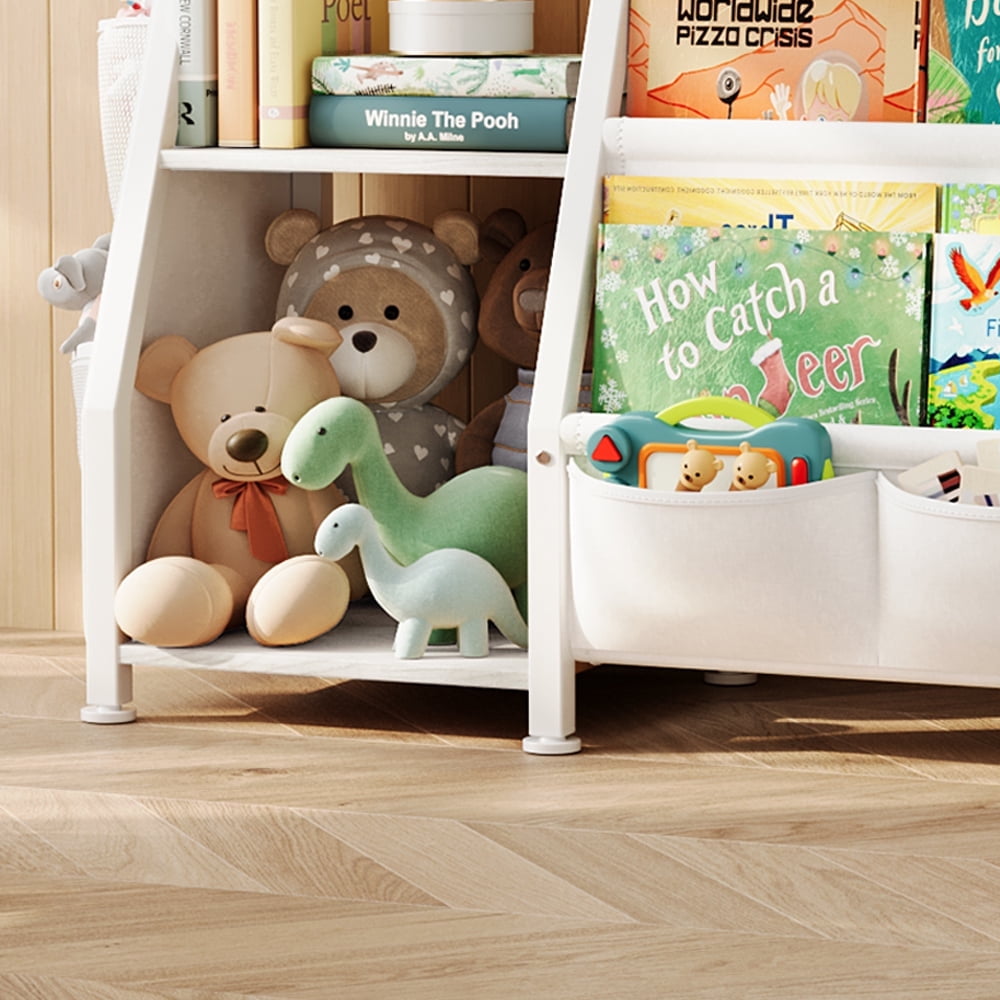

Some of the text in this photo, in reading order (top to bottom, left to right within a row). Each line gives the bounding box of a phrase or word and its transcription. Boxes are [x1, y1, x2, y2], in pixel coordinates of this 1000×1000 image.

[179, 15, 191, 65] CORNWALL
[365, 109, 519, 129] Winnie The Pooh
[404, 131, 464, 143] by A.A. Milne
[633, 260, 719, 335] How
[657, 262, 840, 381] to Catch a
